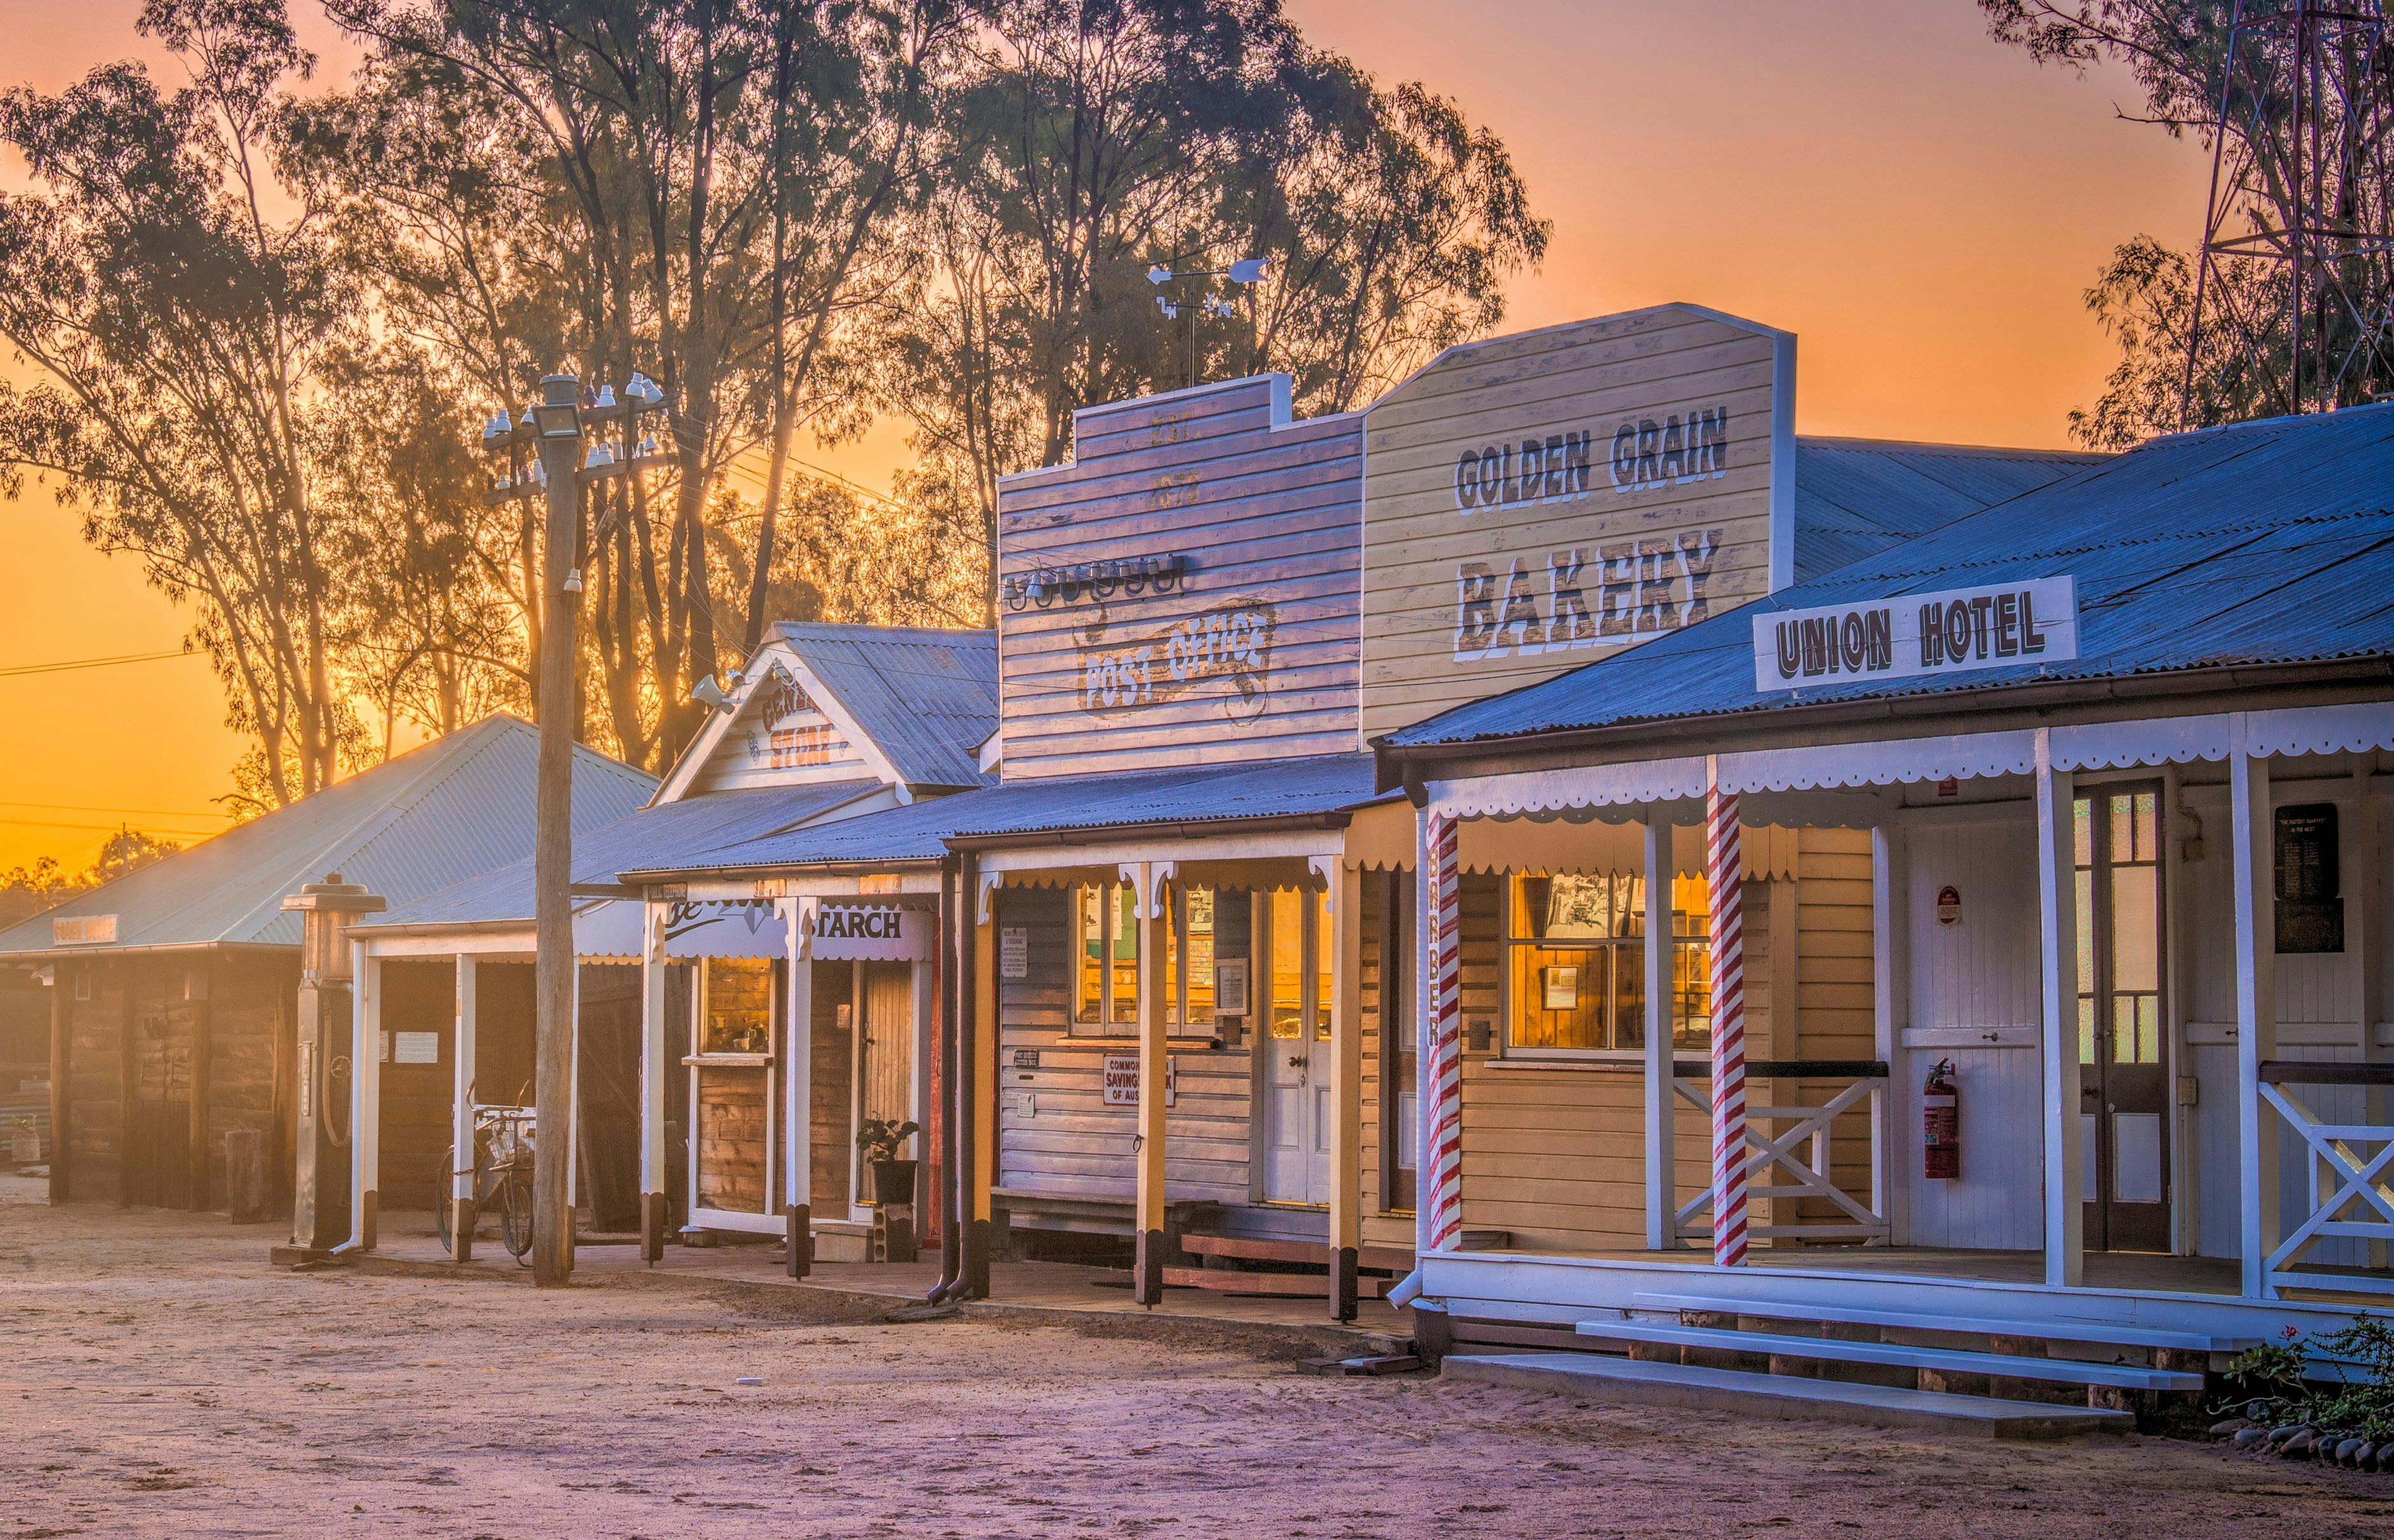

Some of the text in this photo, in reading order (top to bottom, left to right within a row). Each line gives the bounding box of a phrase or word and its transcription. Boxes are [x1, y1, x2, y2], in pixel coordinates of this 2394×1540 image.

[1454, 406, 1727, 516] GOLDEN GRAIN
[1453, 529, 1723, 662] BAKERY
[1776, 591, 2046, 679] UNION HOTEL
[1085, 613, 1267, 709] POST OFFICE
[770, 725, 832, 770] STORE
[812, 911, 902, 937] TARCH
[1429, 847, 1439, 1046] BARBER
[1106, 1072, 1139, 1088] SAVING
[1113, 1090, 1122, 1100] OF
